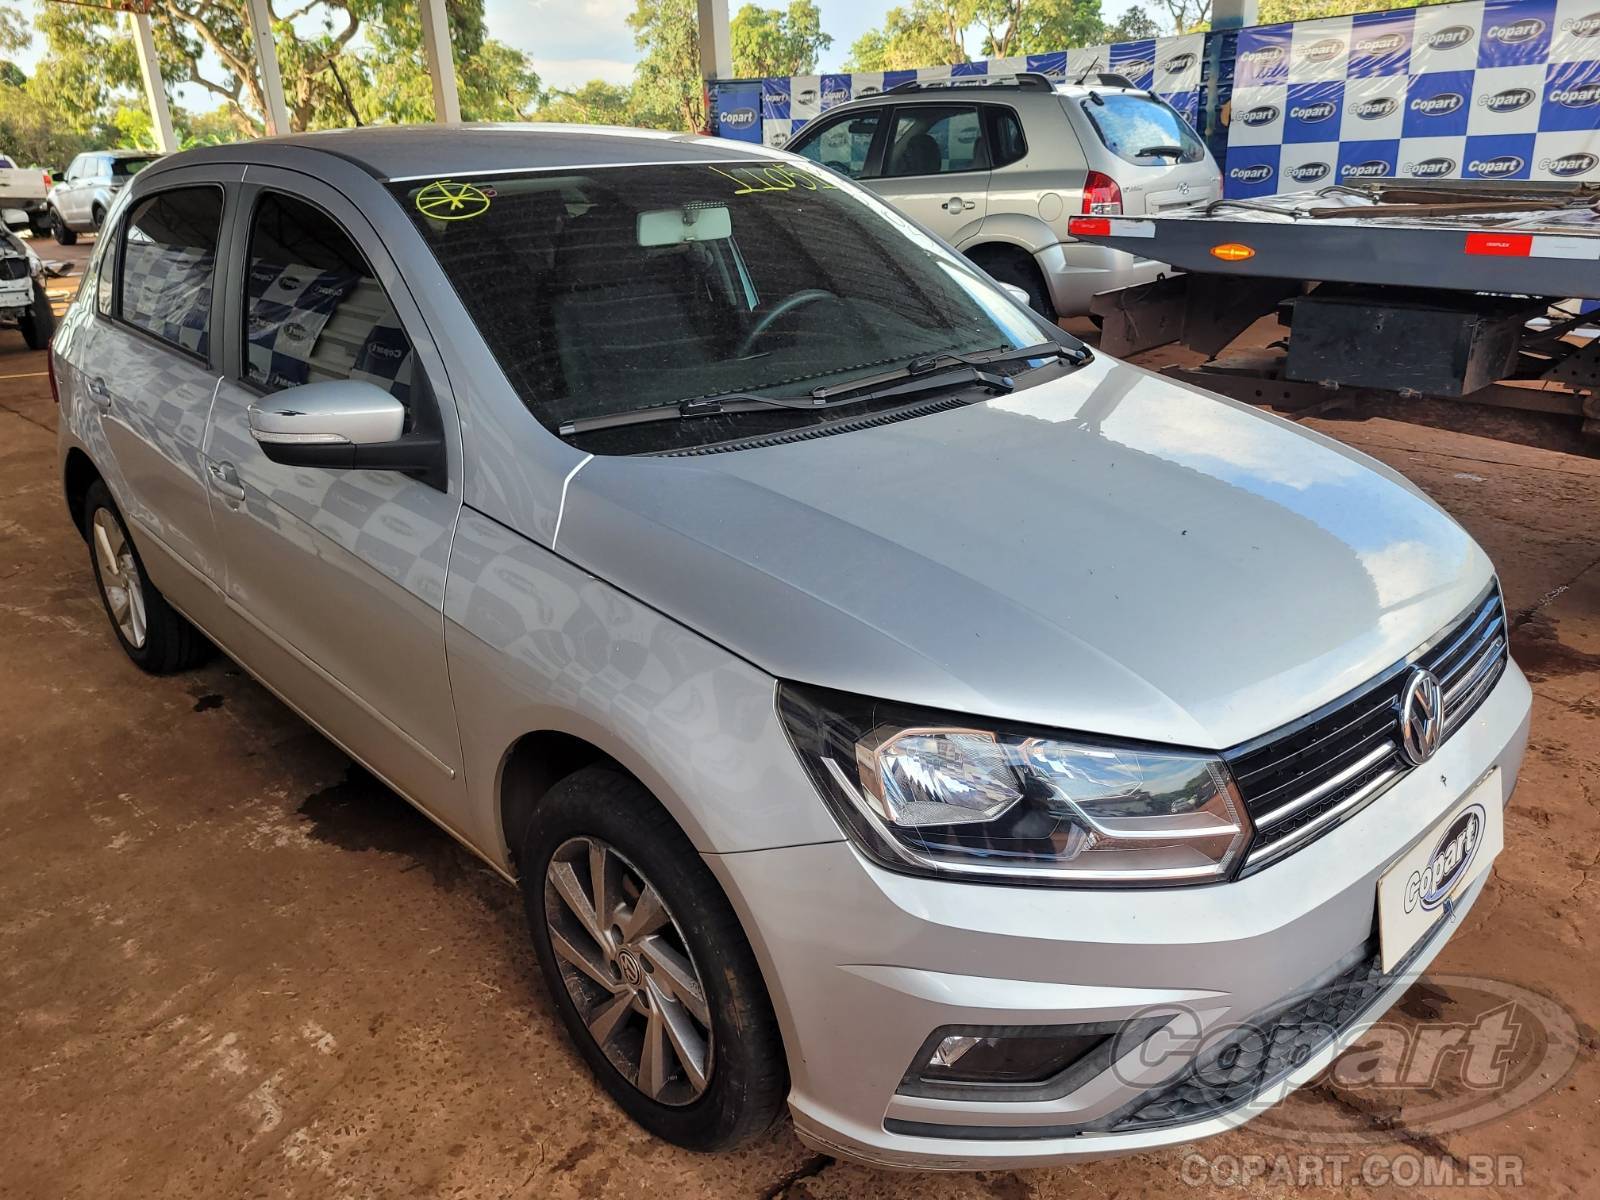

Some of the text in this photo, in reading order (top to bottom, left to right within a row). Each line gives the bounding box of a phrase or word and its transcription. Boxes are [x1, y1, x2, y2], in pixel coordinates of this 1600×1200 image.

[1487, 22, 1537, 38] Copart
[1561, 17, 1600, 31] Copa
[1421, 30, 1466, 45] Copart
[1355, 38, 1398, 52] Copart
[1240, 49, 1279, 64] Copart
[1411, 98, 1456, 111] Copart
[1478, 93, 1527, 107] Copart
[1236, 109, 1273, 122] Copart
[1290, 106, 1330, 120] Copart
[1348, 102, 1391, 116] Copart
[720, 112, 752, 125] Copart
[1341, 162, 1384, 176] Copart
[1403, 162, 1448, 174] Copart
[1468, 160, 1517, 174] Copart
[1539, 157, 1590, 171] Copart
[1230, 168, 1268, 180] Copart
[1285, 165, 1324, 179] Copart
[1404, 812, 1477, 914] Copart
